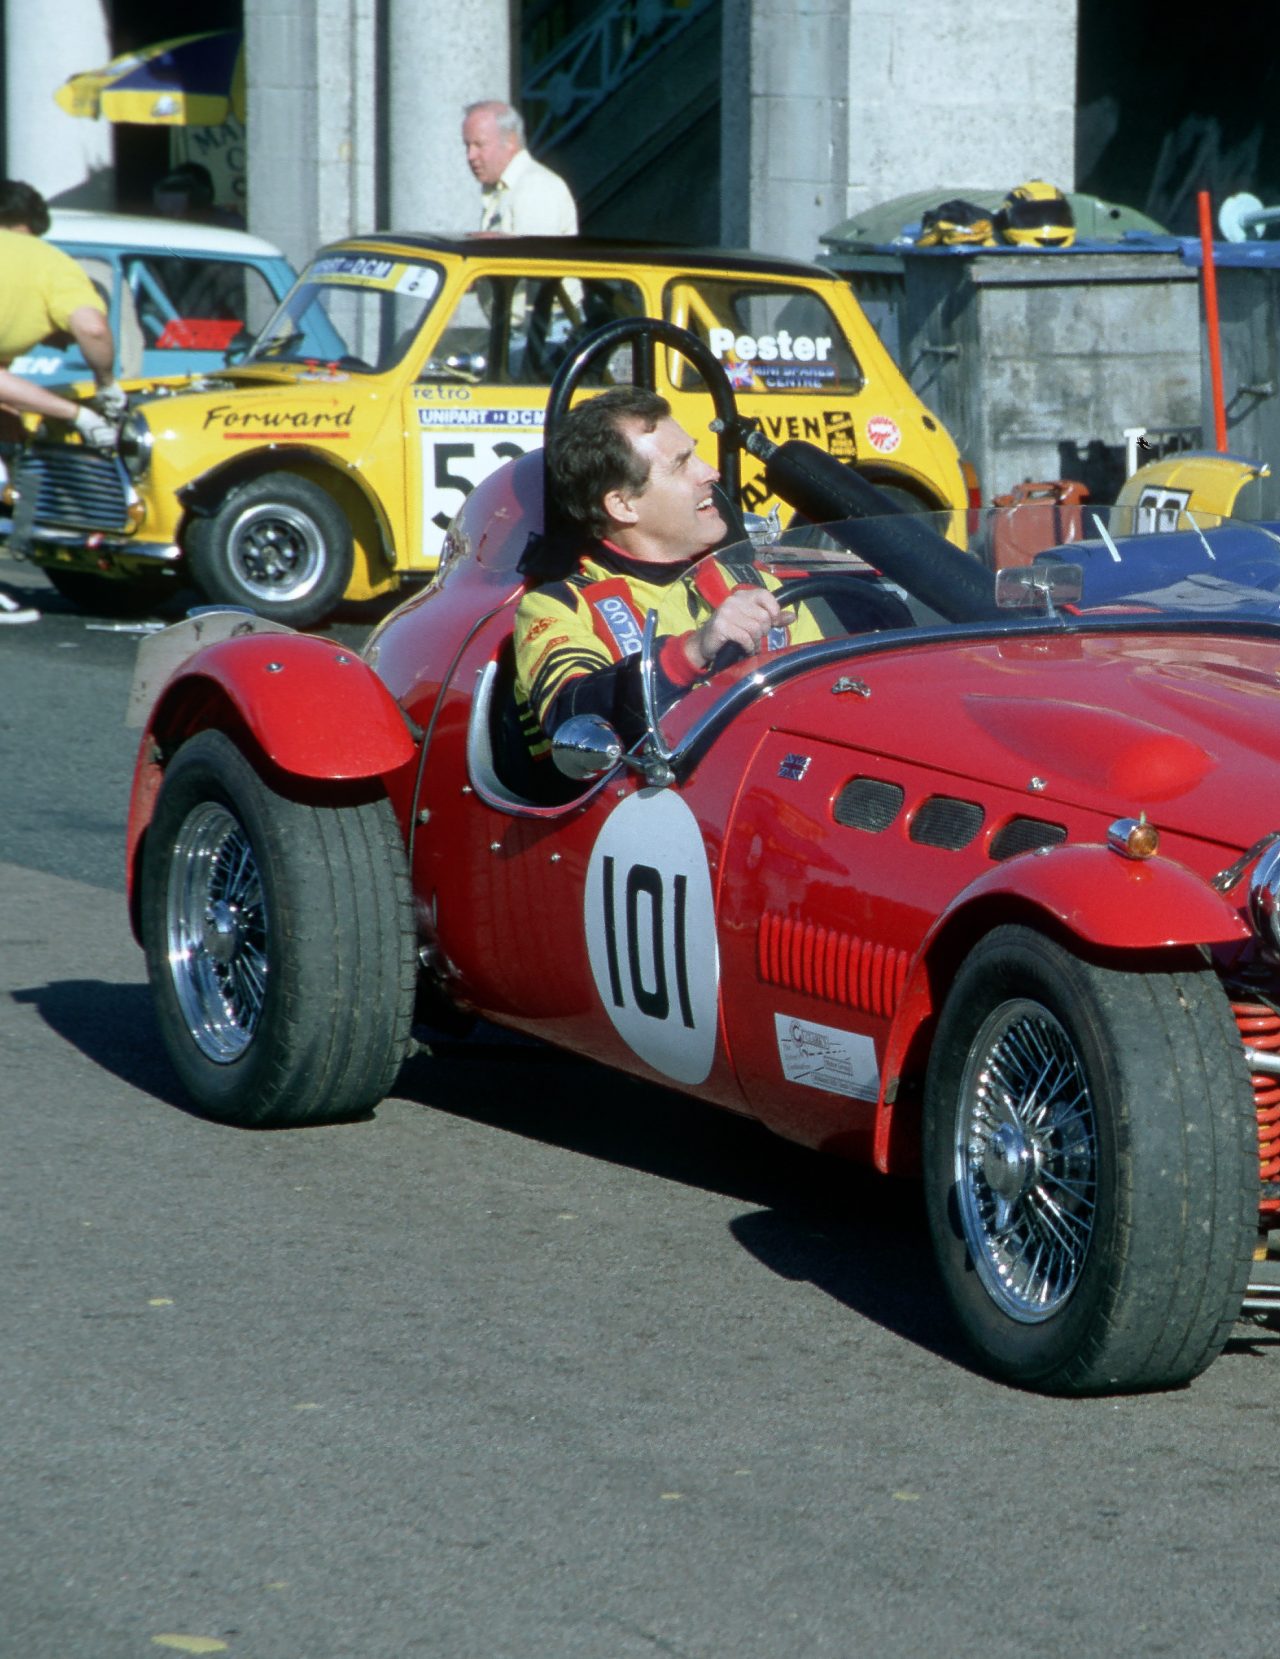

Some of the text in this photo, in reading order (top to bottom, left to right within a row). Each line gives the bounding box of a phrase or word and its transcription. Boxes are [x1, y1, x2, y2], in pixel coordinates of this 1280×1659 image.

[709, 327, 832, 361] Pester
[203, 404, 356, 430] Forward
[420, 411, 487, 424] UNIPART
[603, 855, 696, 1030] 101
